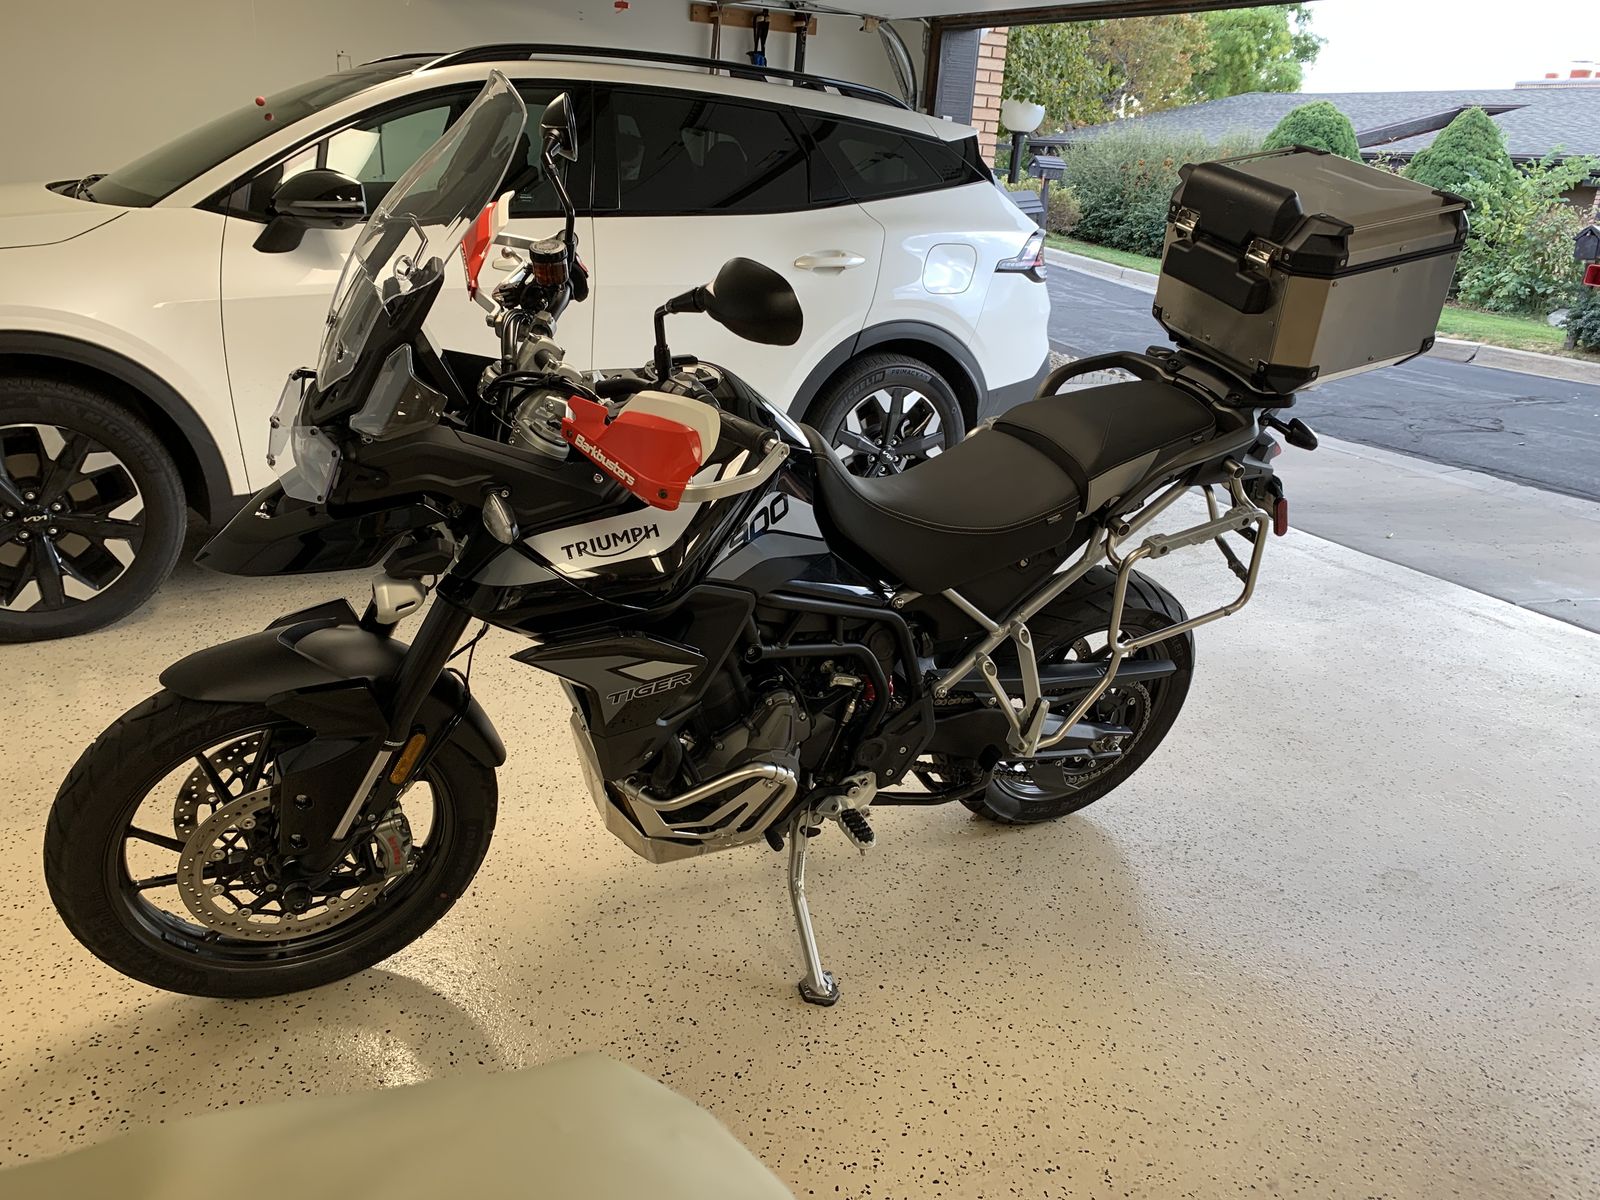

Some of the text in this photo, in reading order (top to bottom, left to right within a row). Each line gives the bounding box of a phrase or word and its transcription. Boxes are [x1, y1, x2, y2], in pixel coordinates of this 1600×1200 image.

[837, 370, 885, 411] MICHELIN
[575, 434, 636, 486] Barkbusters
[560, 522, 661, 560] TRIUMPH
[606, 672, 693, 705] TIGER
